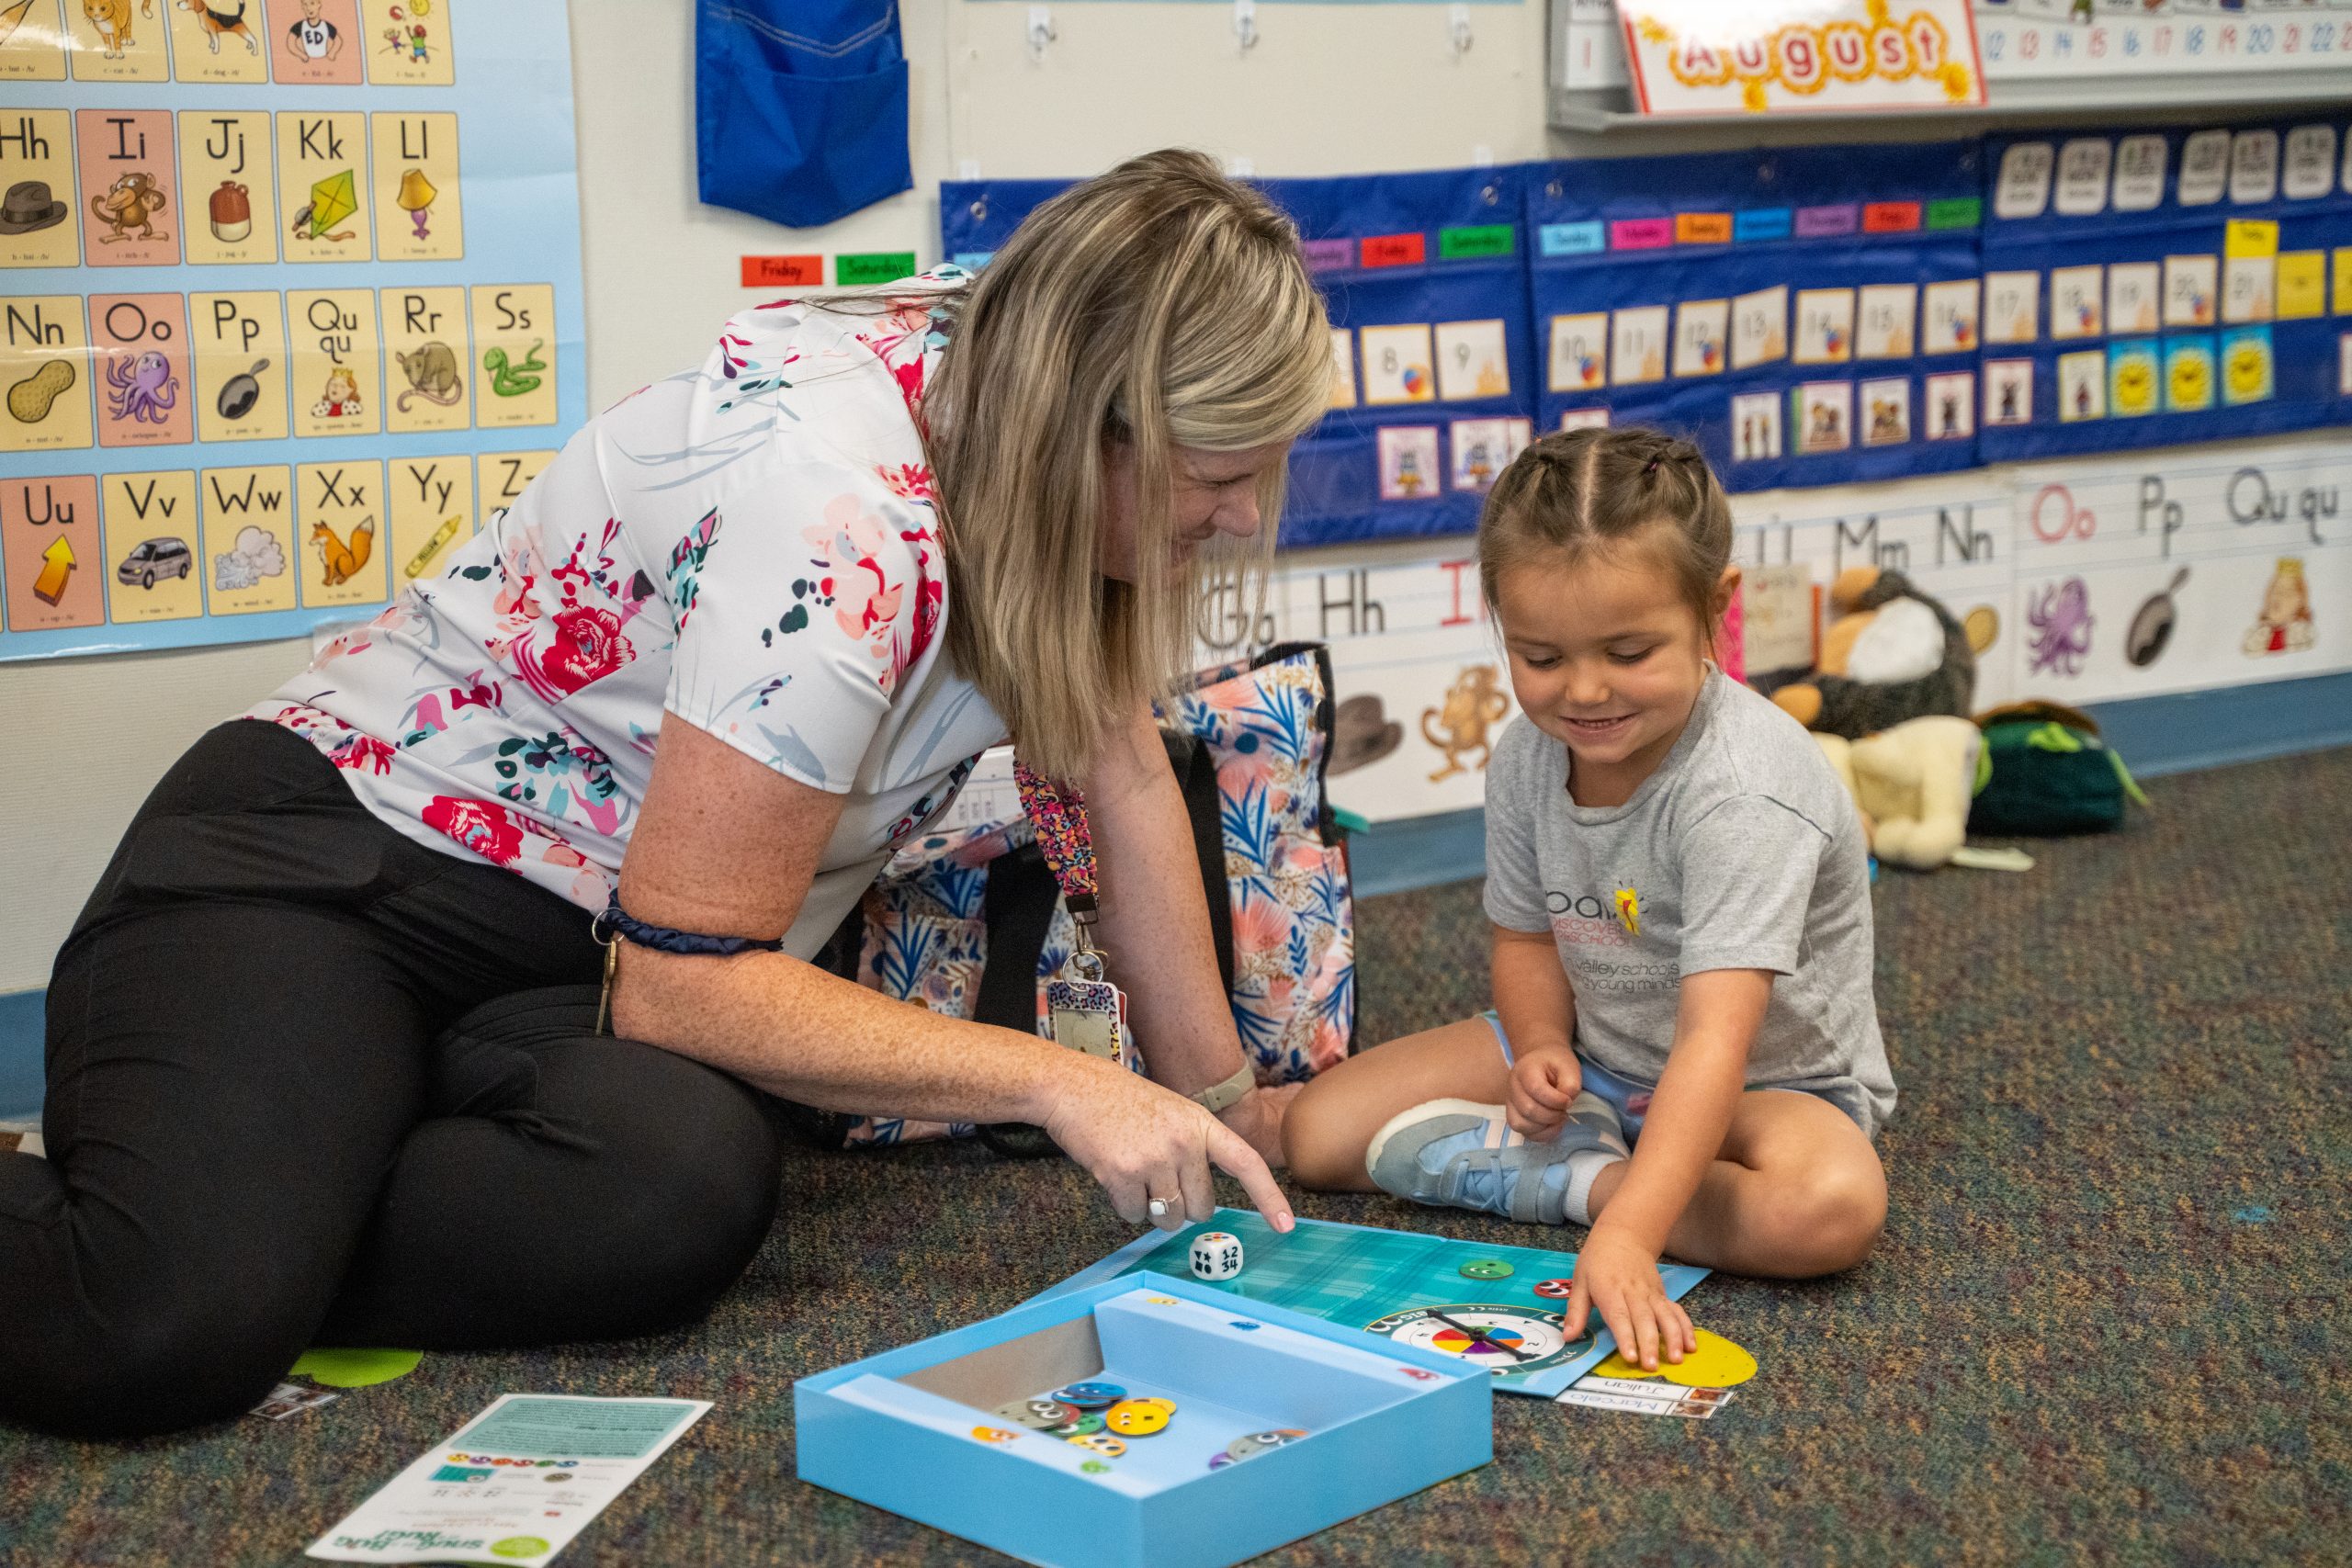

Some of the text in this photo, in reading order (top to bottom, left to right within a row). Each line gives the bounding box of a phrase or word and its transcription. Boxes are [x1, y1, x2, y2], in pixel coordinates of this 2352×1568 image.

[304, 30, 323, 45] ED
[2246, 24, 2274, 54] 20
[2310, 24, 2335, 53] 22
[107, 118, 145, 161] Ii
[207, 119, 245, 174] Jj
[300, 119, 345, 161] Kk
[401, 119, 429, 161] Ll
[761, 258, 803, 281] Friday
[7, 304, 63, 346] Nn
[106, 302, 173, 343] Oo
[214, 299, 261, 353] Pp
[308, 299, 357, 333] Qu
[404, 295, 443, 333] Rr
[494, 292, 531, 331] Ss
[319, 333, 352, 364] qu
[1382, 346, 1399, 374] 8
[1454, 343, 1471, 370] 9
[1561, 334, 1587, 364] 10
[211, 474, 282, 514] Ww
[316, 469, 366, 509] Xx
[409, 463, 454, 514] Yy
[499, 459, 537, 497] Z
[24, 484, 74, 525] Uu
[124, 479, 176, 520] Vv
[2030, 483, 2097, 544] Oo
[2138, 475, 2185, 558] Pp
[2225, 466, 2340, 545] Qu qu
[1935, 503, 1995, 567] Nn
[1318, 568, 1385, 639] Hh
[1577, 959, 1620, 976] valley
[1622, 963, 1680, 976] schools
[1591, 977, 1634, 993] young
[1570, 1393, 1658, 1412] Marcelo
[1604, 1380, 1665, 1394] Julian
